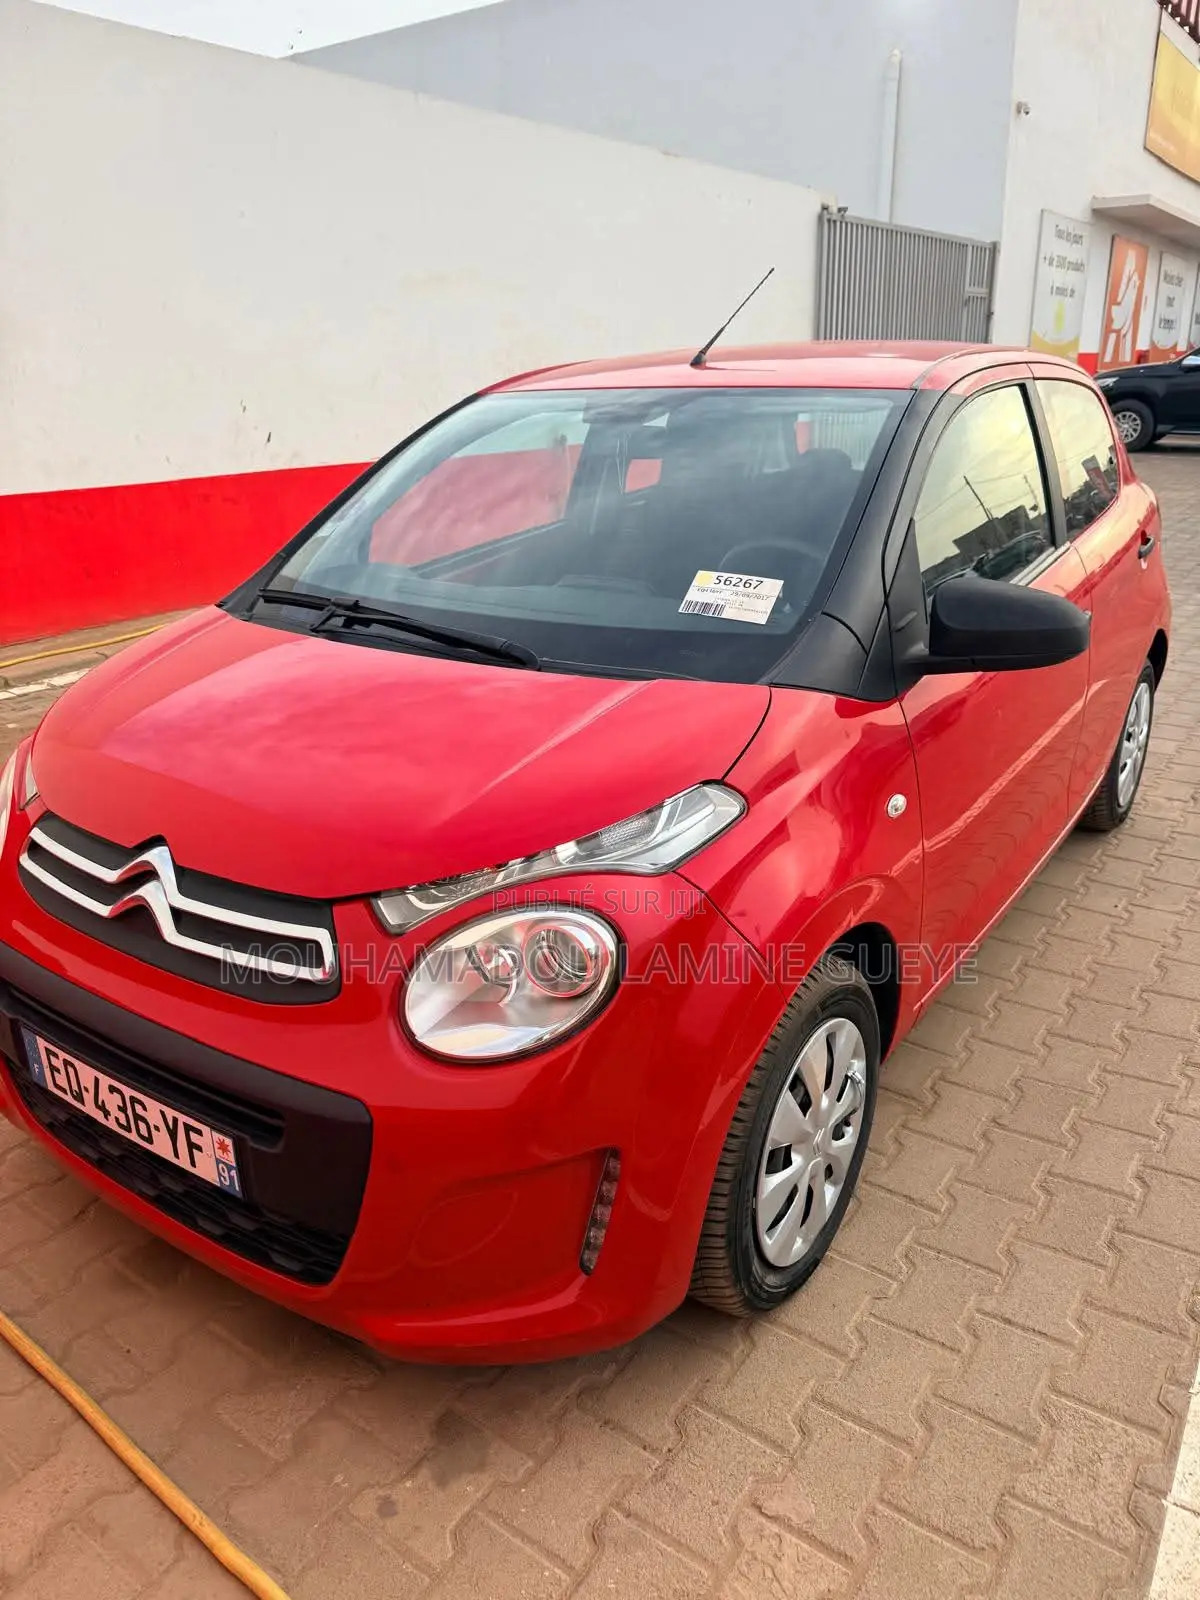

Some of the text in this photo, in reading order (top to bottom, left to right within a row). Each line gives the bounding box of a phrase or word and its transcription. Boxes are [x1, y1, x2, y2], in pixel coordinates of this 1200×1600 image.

[713, 575, 764, 590] 56267
[44, 1046, 204, 1169] EQ-436-YF
[219, 1163, 240, 1191] 91
